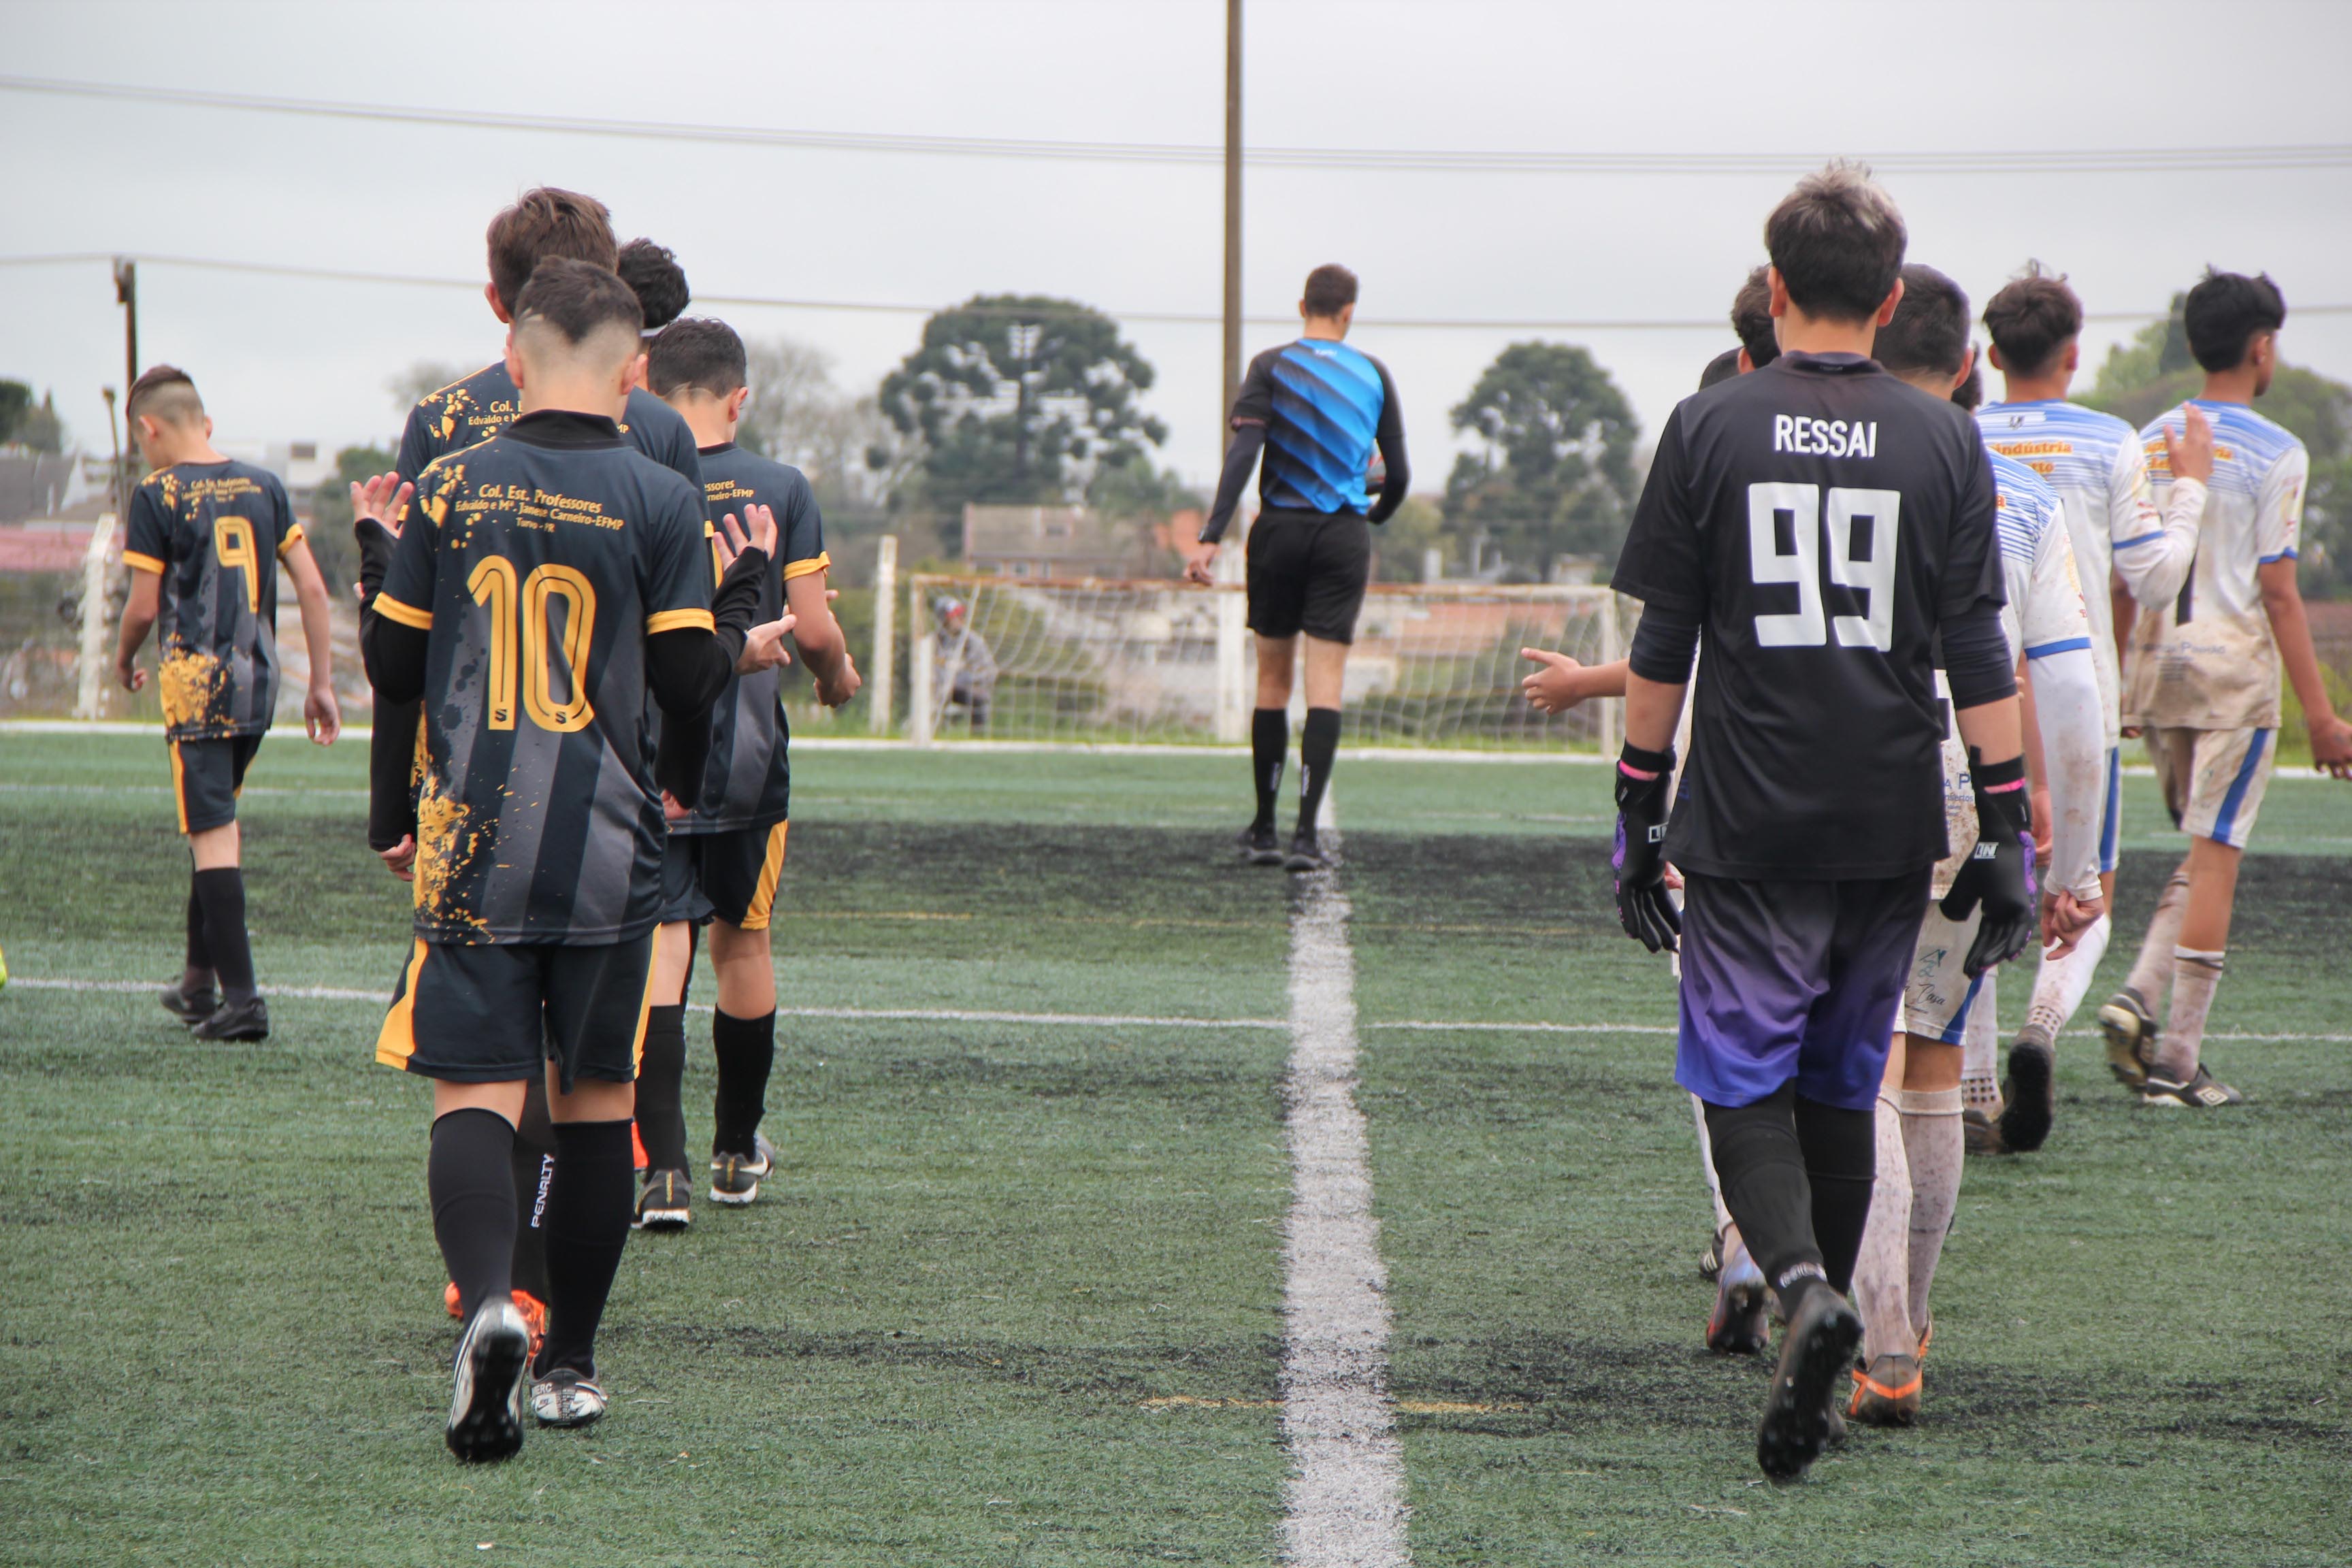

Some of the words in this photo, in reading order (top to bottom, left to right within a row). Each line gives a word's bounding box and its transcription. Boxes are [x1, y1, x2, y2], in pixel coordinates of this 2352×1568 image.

[468, 413, 502, 425] Edvaldo
[490, 400, 514, 412] Col.
[1775, 414, 1878, 457] RESSAI
[455, 500, 489, 512] Edvaldo
[490, 502, 497, 510] e
[519, 502, 548, 518] Janete
[550, 508, 625, 531] Carneiro-EFMP
[479, 483, 504, 498] Col.
[508, 485, 531, 502] Est.
[534, 489, 603, 514] Professores
[214, 515, 259, 615] 9
[1748, 482, 1901, 652] 99
[466, 555, 597, 733] 10
[530, 1153, 555, 1228] PENALTY
